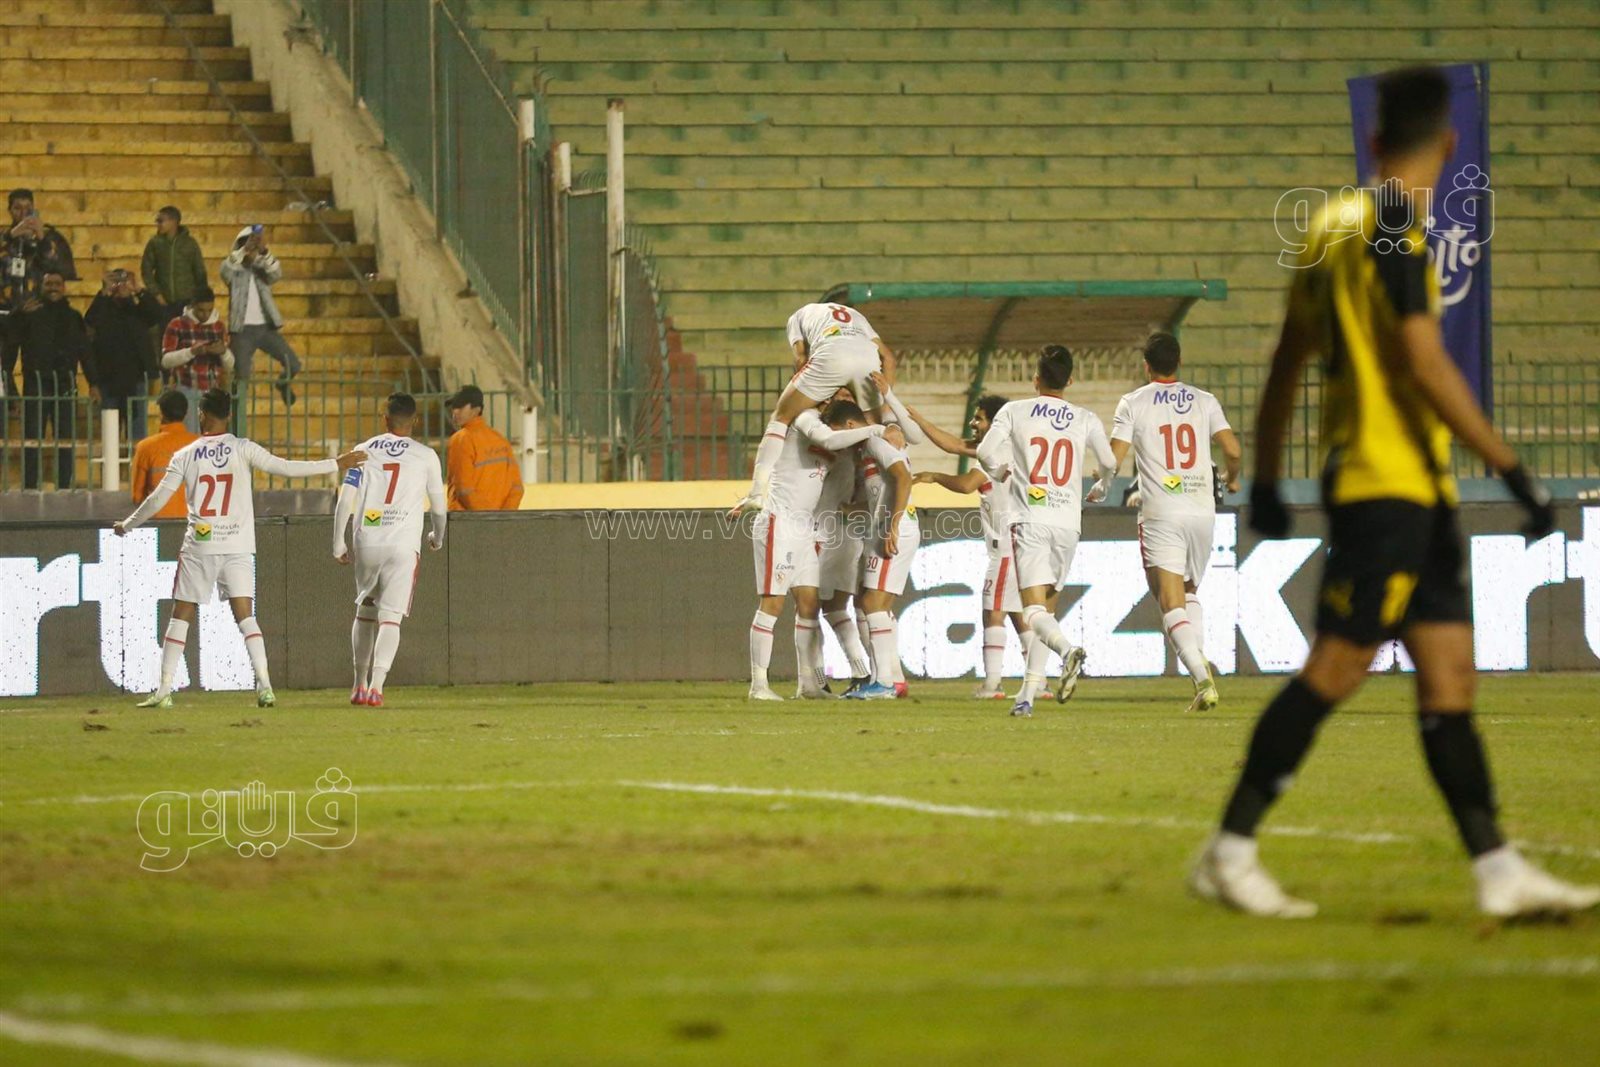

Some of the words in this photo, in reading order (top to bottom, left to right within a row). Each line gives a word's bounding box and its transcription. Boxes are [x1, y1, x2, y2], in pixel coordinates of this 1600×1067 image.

[1427, 215, 1481, 289] lto
[1030, 403, 1074, 424] Molto
[1153, 388, 1195, 408] Molto
[193, 442, 232, 462] Molto
[369, 439, 409, 453] Molto
[1029, 436, 1074, 487] 20
[1159, 423, 1197, 470] 19
[199, 473, 234, 517] 27
[383, 463, 400, 504] 7
